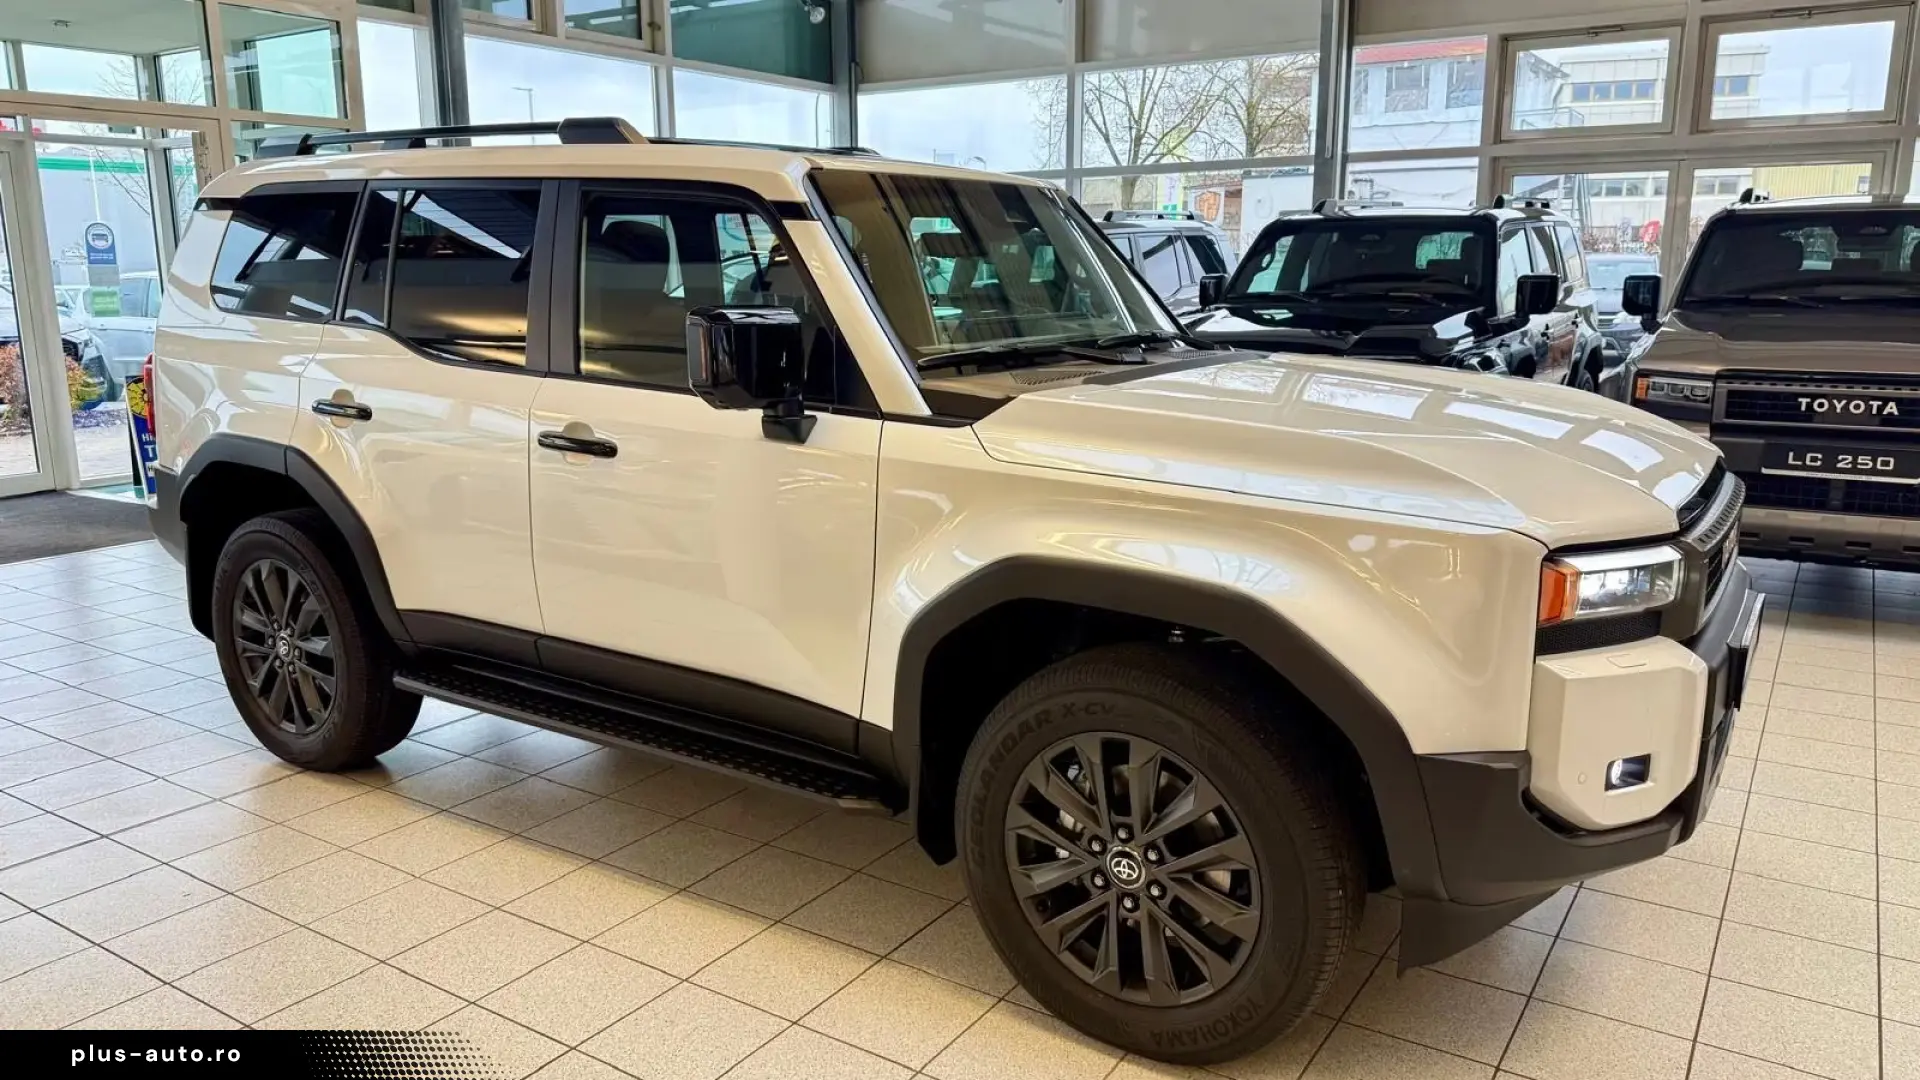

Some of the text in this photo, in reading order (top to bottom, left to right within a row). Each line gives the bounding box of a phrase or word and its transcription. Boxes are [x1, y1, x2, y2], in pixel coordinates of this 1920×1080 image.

[1798, 398, 1899, 415] TOYOTA
[1788, 451, 1895, 470] LC 250
[1061, 702, 1117, 719] X-CV
[1150, 997, 1265, 1048] YOKOHAMA
